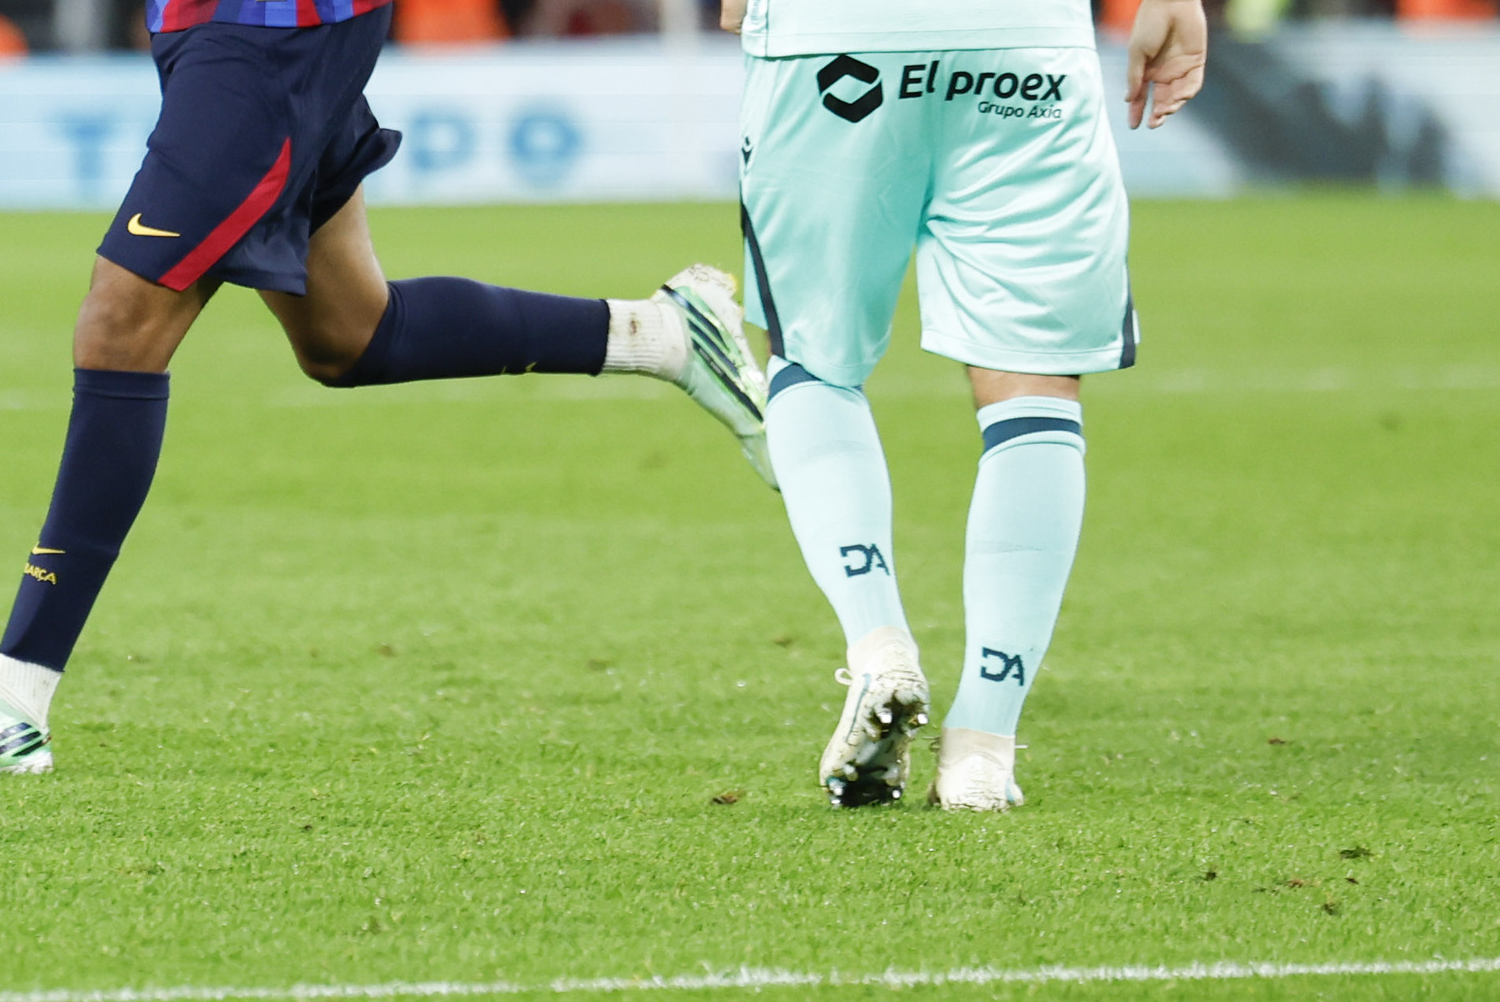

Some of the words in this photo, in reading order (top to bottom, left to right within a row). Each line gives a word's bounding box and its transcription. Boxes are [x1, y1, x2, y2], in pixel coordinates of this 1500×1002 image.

[898, 60, 940, 100] El
[945, 71, 1067, 101] proex
[978, 101, 1024, 119] Grupo
